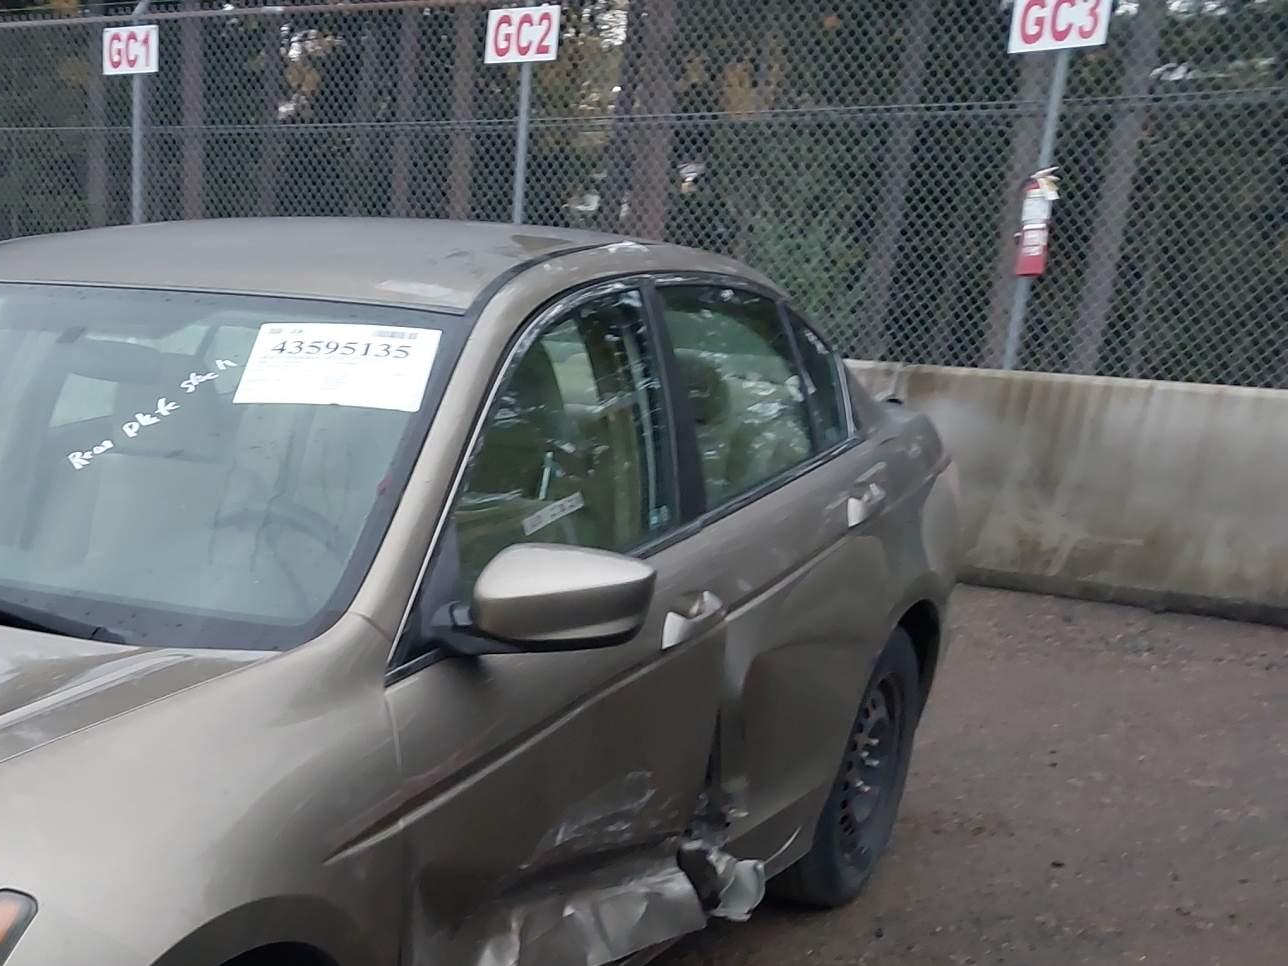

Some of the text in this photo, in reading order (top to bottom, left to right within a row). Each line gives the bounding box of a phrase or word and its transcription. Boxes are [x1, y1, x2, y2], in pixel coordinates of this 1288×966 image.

[494, 12, 553, 57] GC2
[1020, 0, 1101, 44] GC3
[109, 31, 151, 69] GC1
[270, 339, 413, 359] 43595135
